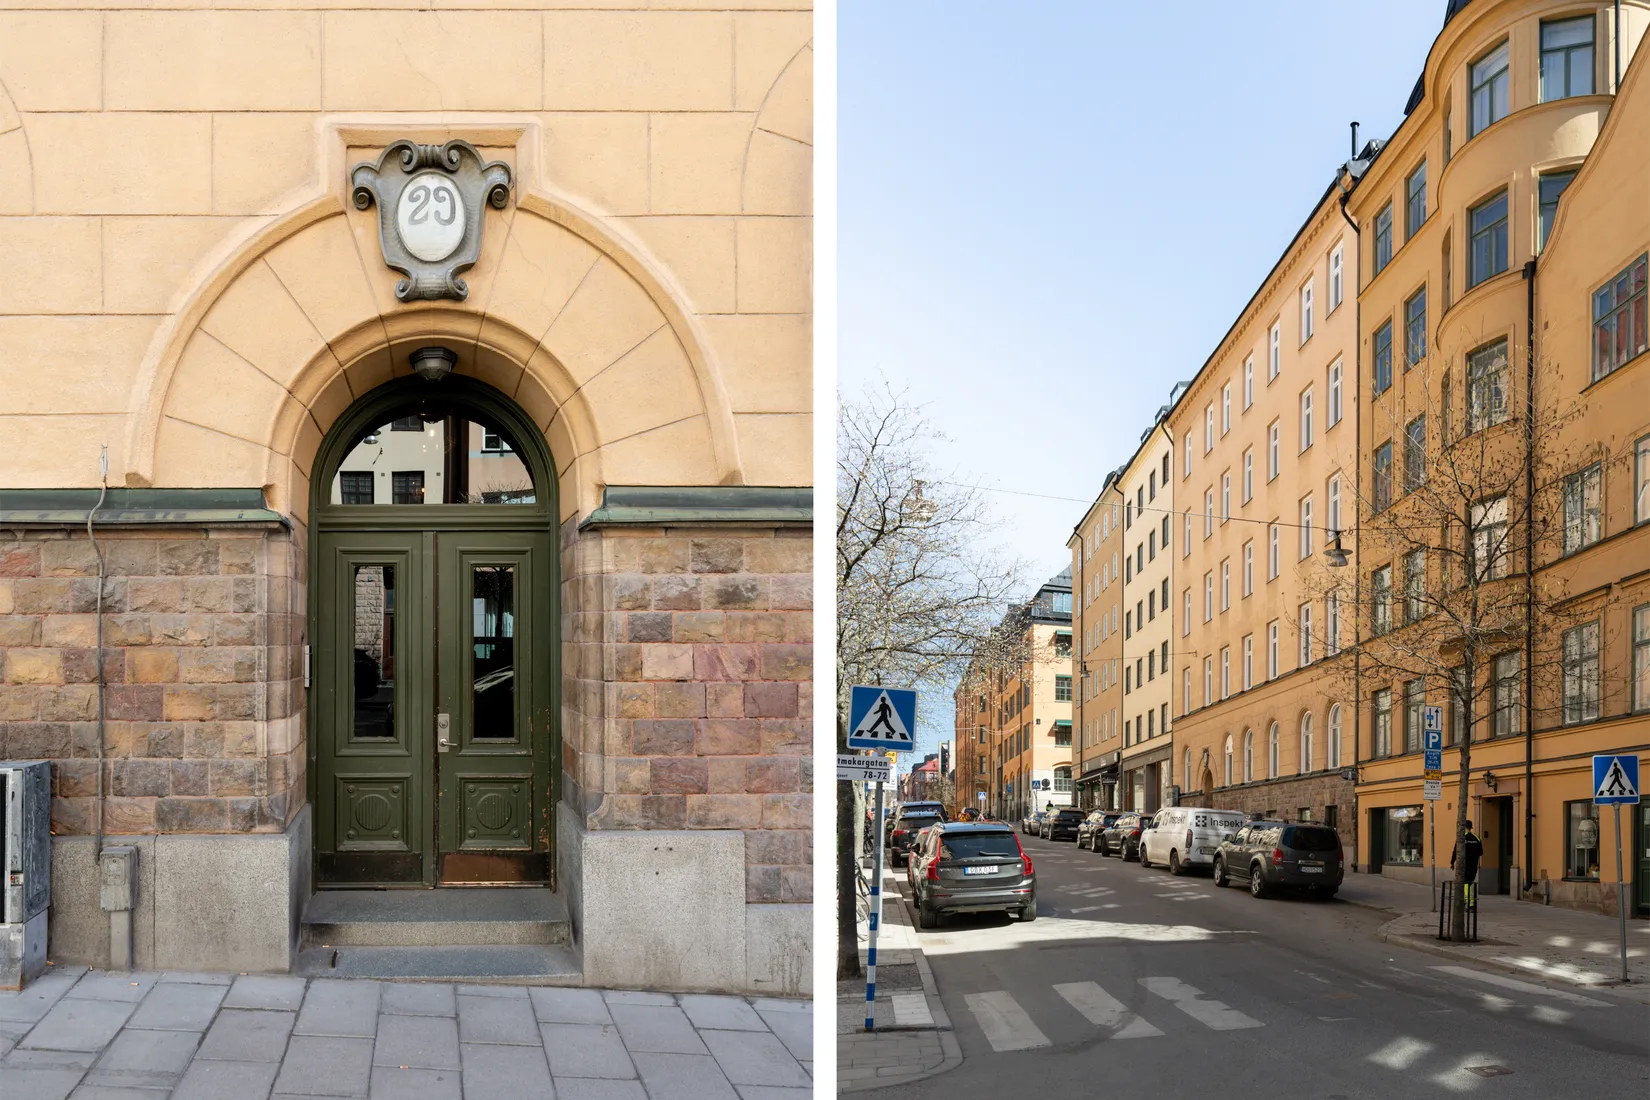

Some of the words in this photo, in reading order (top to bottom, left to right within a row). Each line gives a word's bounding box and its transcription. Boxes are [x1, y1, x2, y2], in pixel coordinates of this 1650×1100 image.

[408, 185, 456, 226] 29
[1429, 732, 1439, 748] P
[863, 770, 887, 780] 78-72
[1210, 817, 1243, 828] Inspekt
